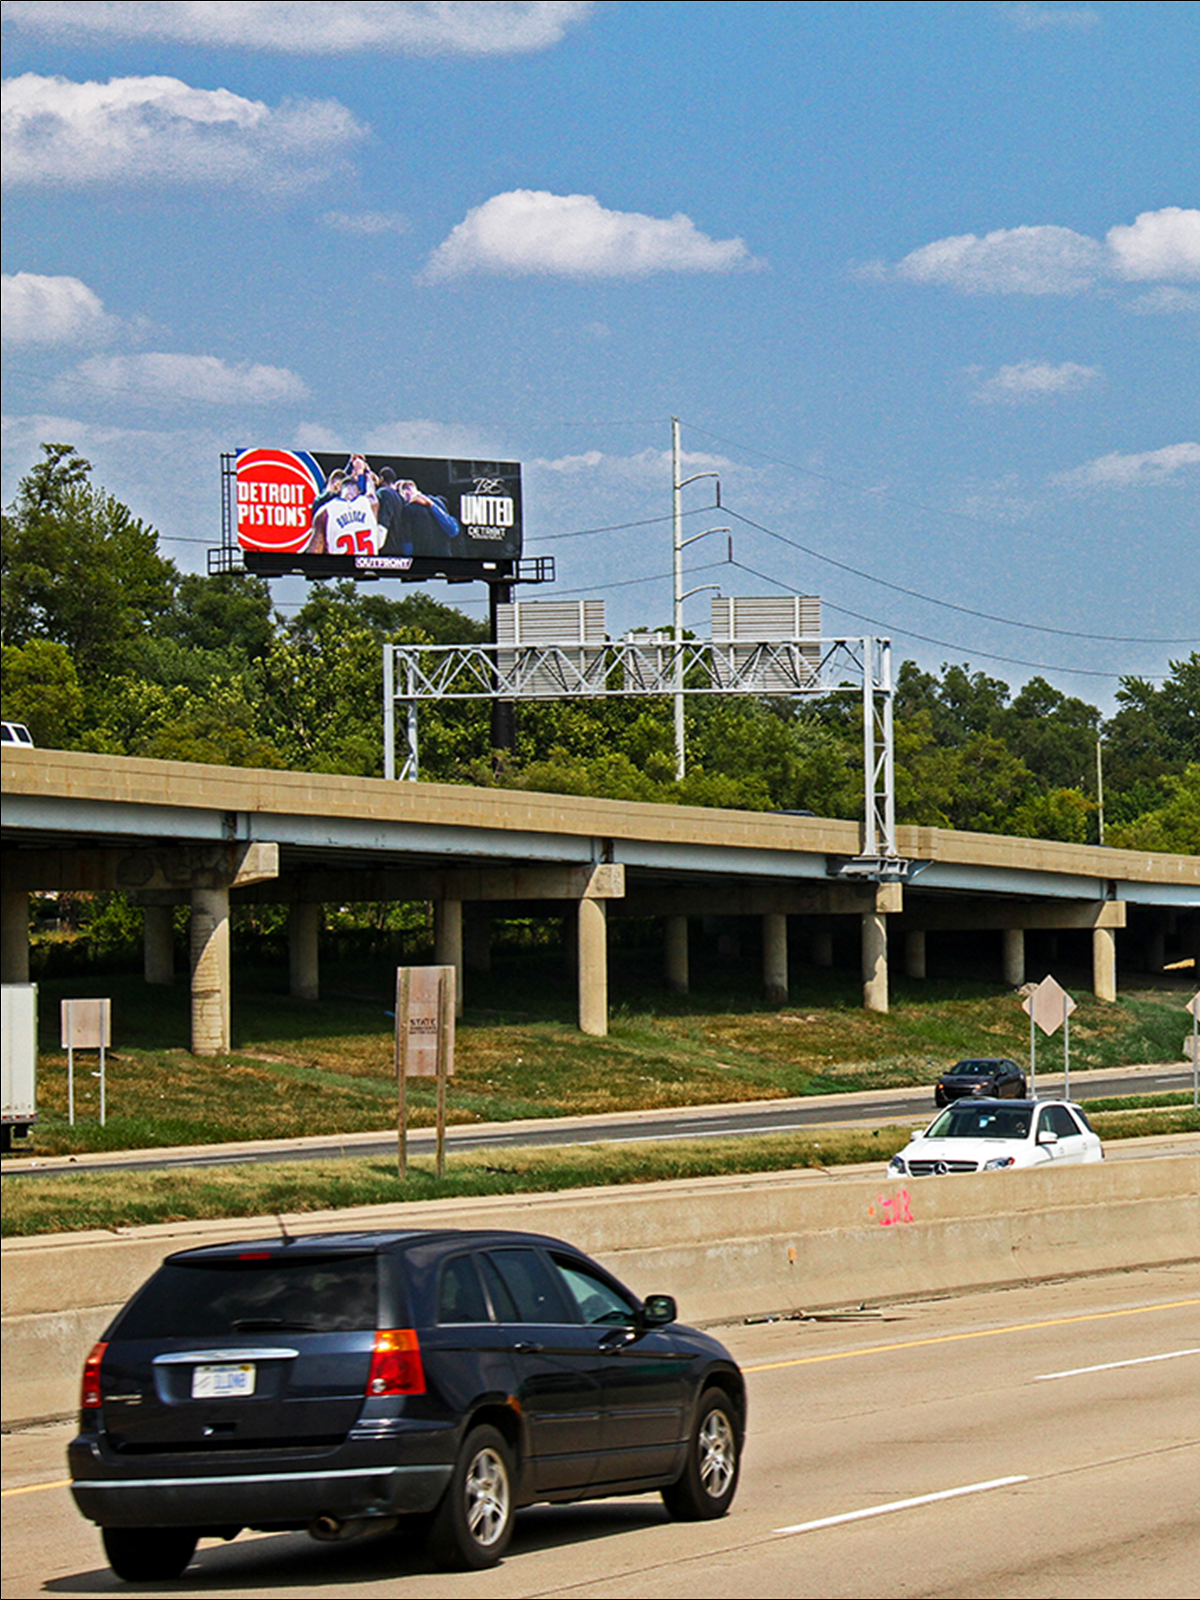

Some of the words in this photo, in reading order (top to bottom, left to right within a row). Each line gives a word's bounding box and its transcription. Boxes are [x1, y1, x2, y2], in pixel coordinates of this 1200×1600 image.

[237, 481, 306, 505] DETROIT
[237, 503, 307, 528] PISTONS
[461, 494, 514, 527] UNITED
[355, 556, 413, 570] OUTFRONT
